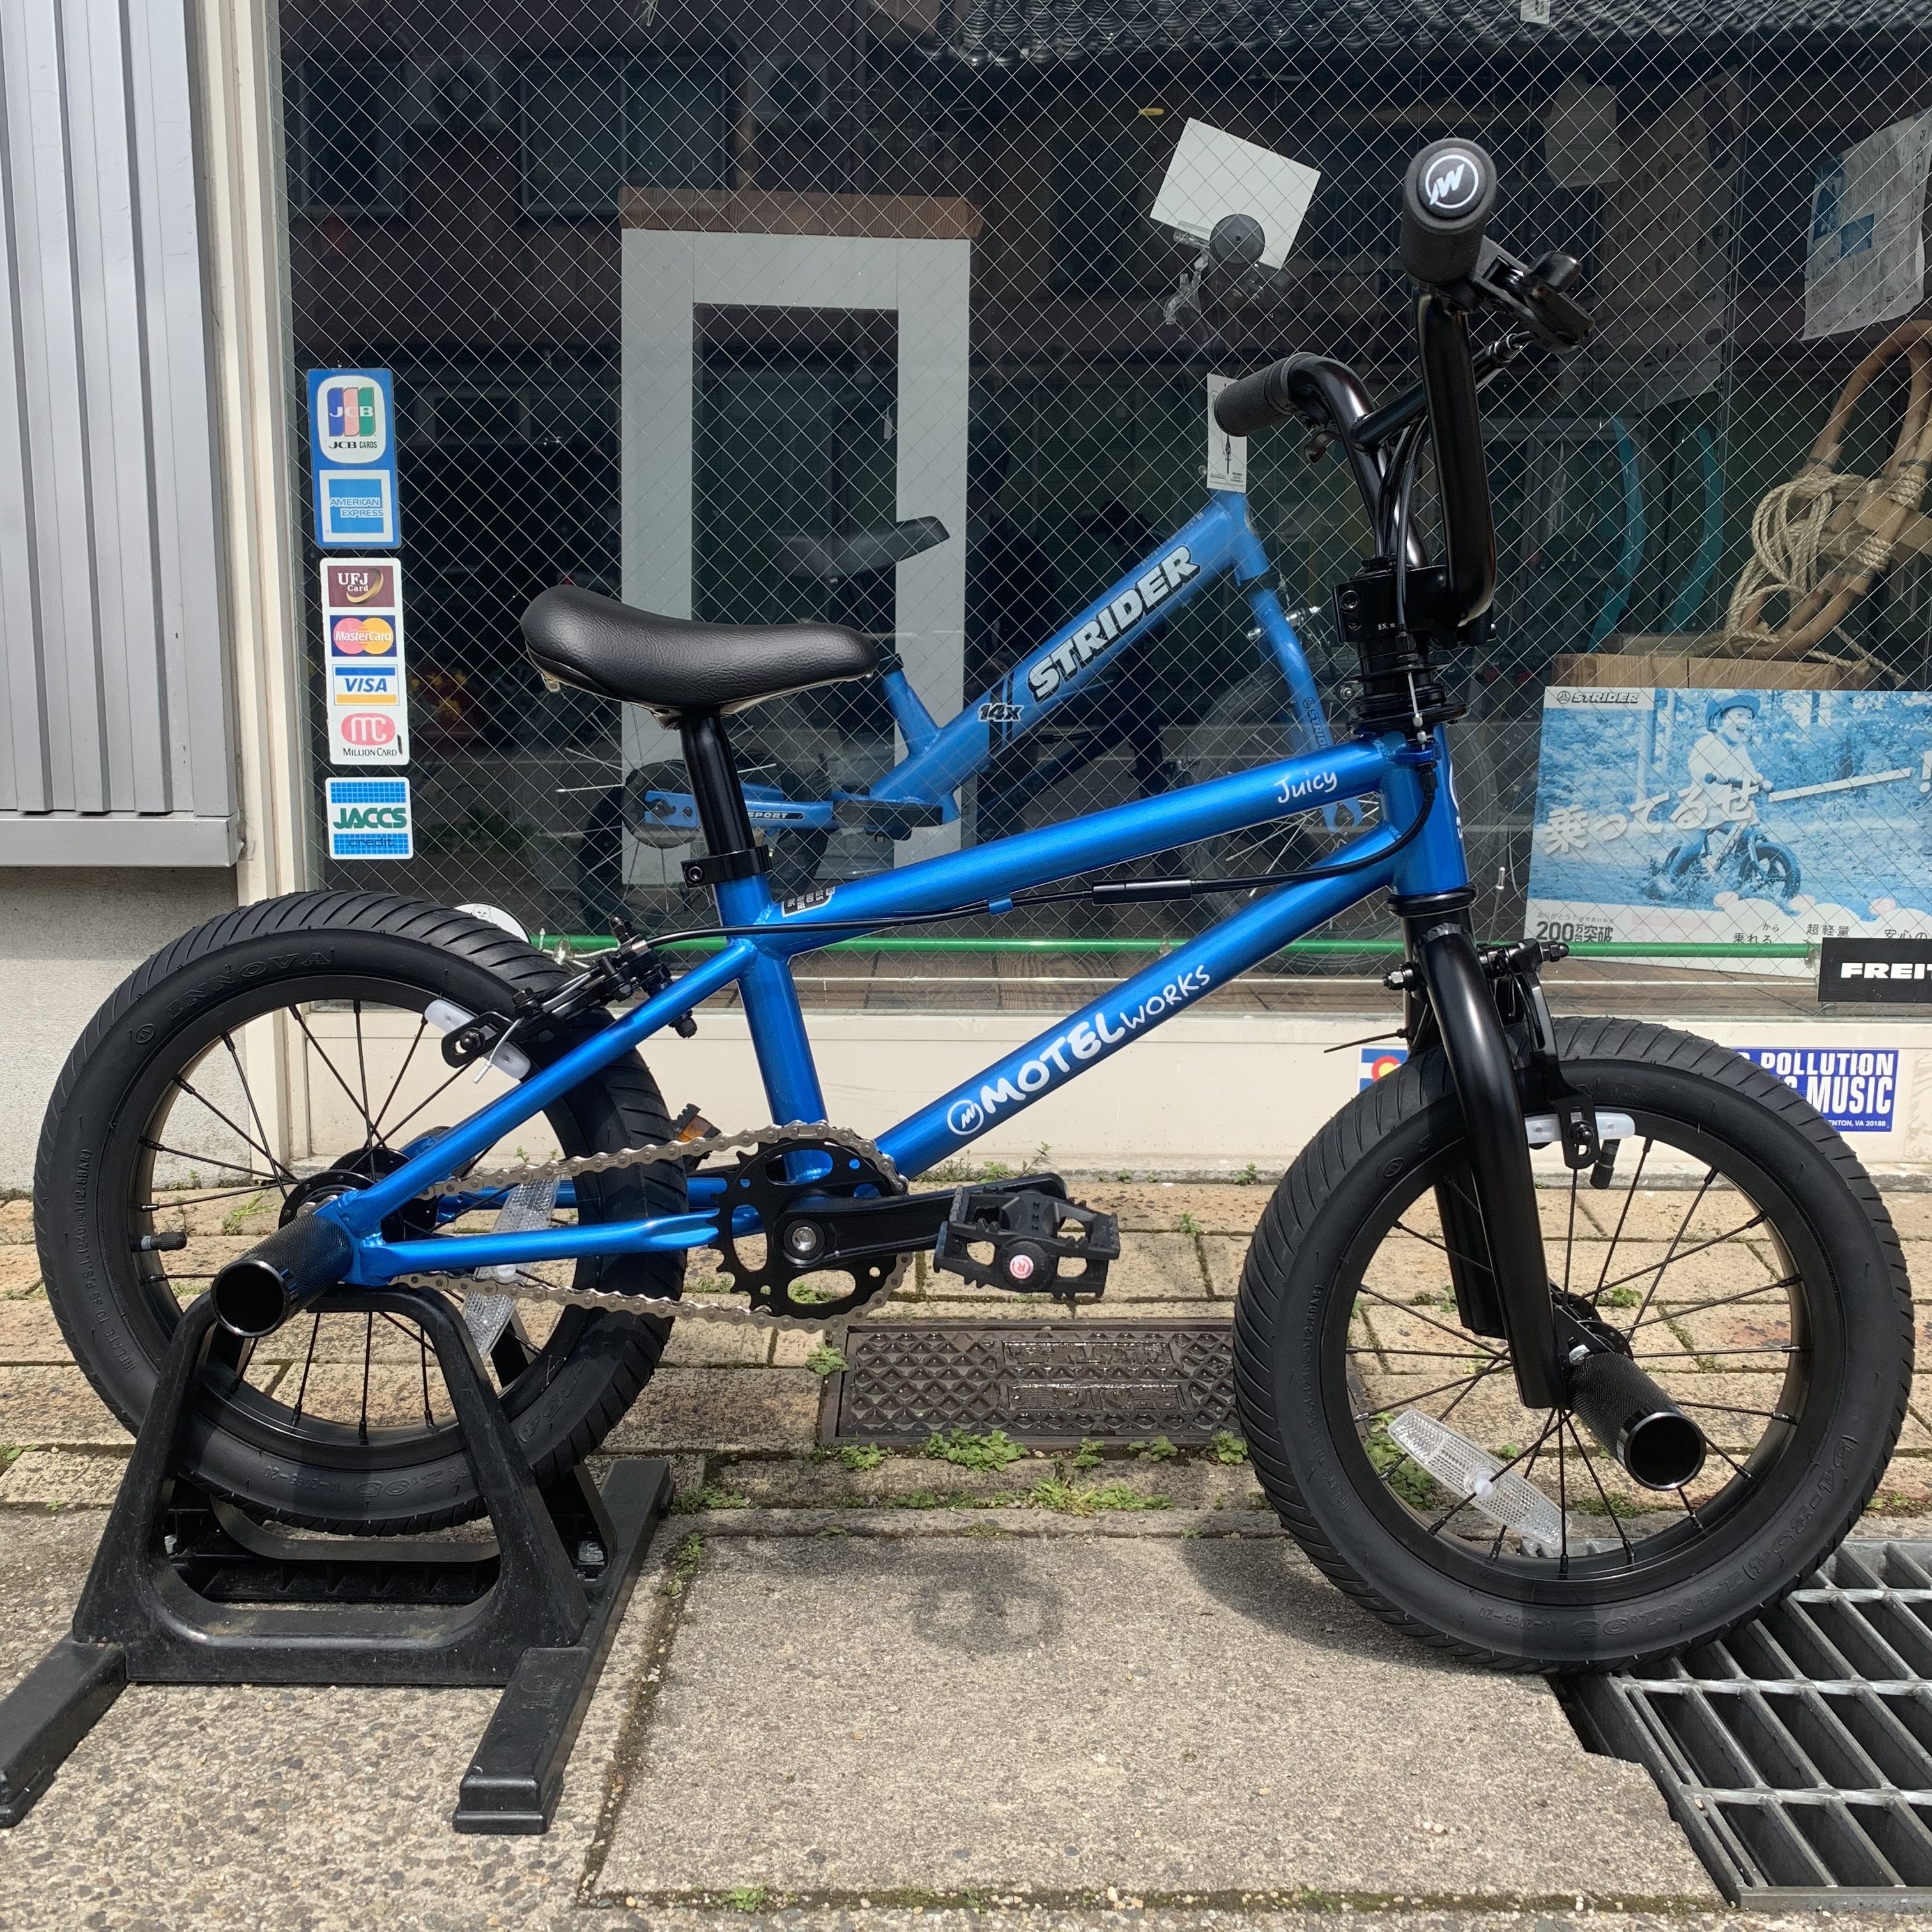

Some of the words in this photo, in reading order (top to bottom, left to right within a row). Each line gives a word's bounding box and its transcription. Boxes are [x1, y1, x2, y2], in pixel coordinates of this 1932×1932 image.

[328, 405, 374, 418] JCB
[330, 497, 380, 507] AMERICAN
[341, 509, 383, 517] EXPRESS
[337, 572, 369, 585] UFJ
[347, 584, 369, 592] Card
[1027, 545, 1201, 704] STRIDER
[335, 631, 392, 642] MasterCard
[344, 678, 388, 693] VISA
[1572, 692, 1639, 703] STRIDER
[1305, 709, 1328, 749] STRID
[342, 747, 376, 756] MILLION
[376, 747, 397, 756] CARD
[1274, 771, 1337, 804] Juicy
[333, 808, 408, 829] JACCS
[349, 837, 394, 847] credit
[1762, 923, 1779, 931] から
[1806, 923, 1850, 937] 超軽量
[980, 1013, 1126, 1114] MOTEL
[1119, 965, 1211, 1029] WORKS
[1761, 1052, 1894, 1076] POLLUTION
[1805, 1076, 1893, 1114] MUSIC
